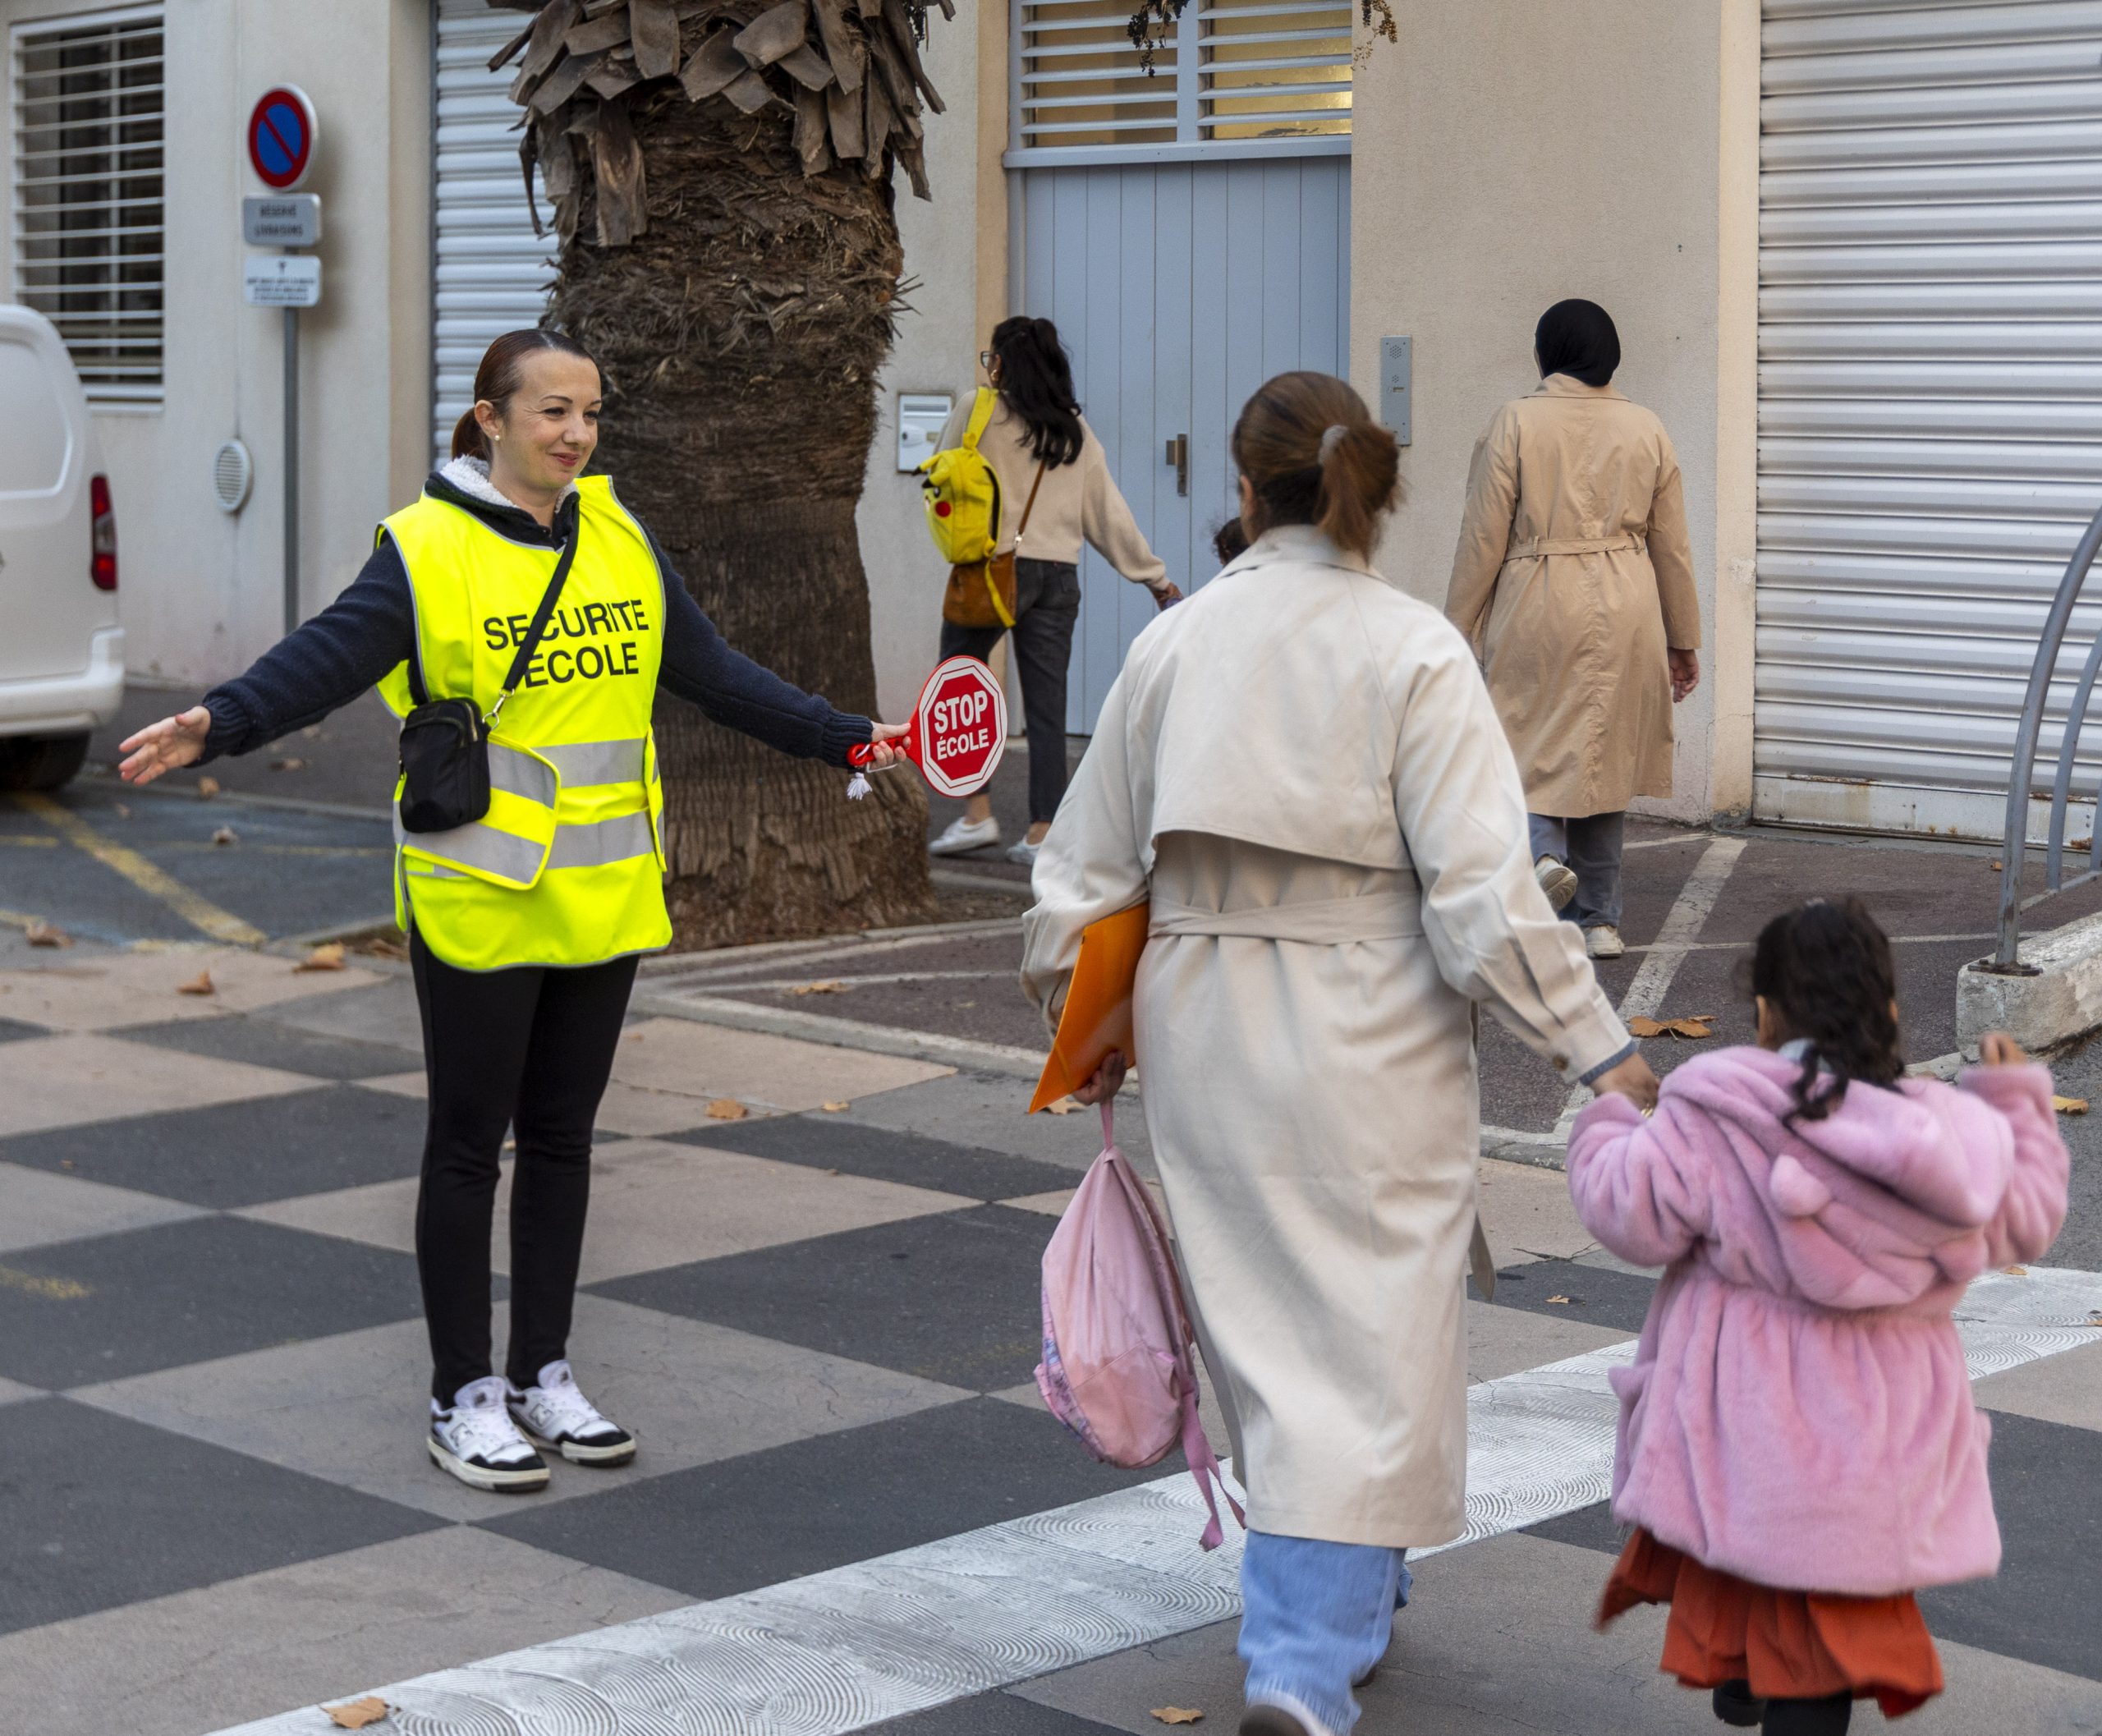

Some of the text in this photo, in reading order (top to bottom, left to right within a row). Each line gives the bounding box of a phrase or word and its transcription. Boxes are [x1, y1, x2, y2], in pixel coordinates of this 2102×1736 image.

[525, 642, 639, 687] ECOLE
[934, 691, 988, 733] STOP
[937, 728, 989, 760] ÉCOLE
